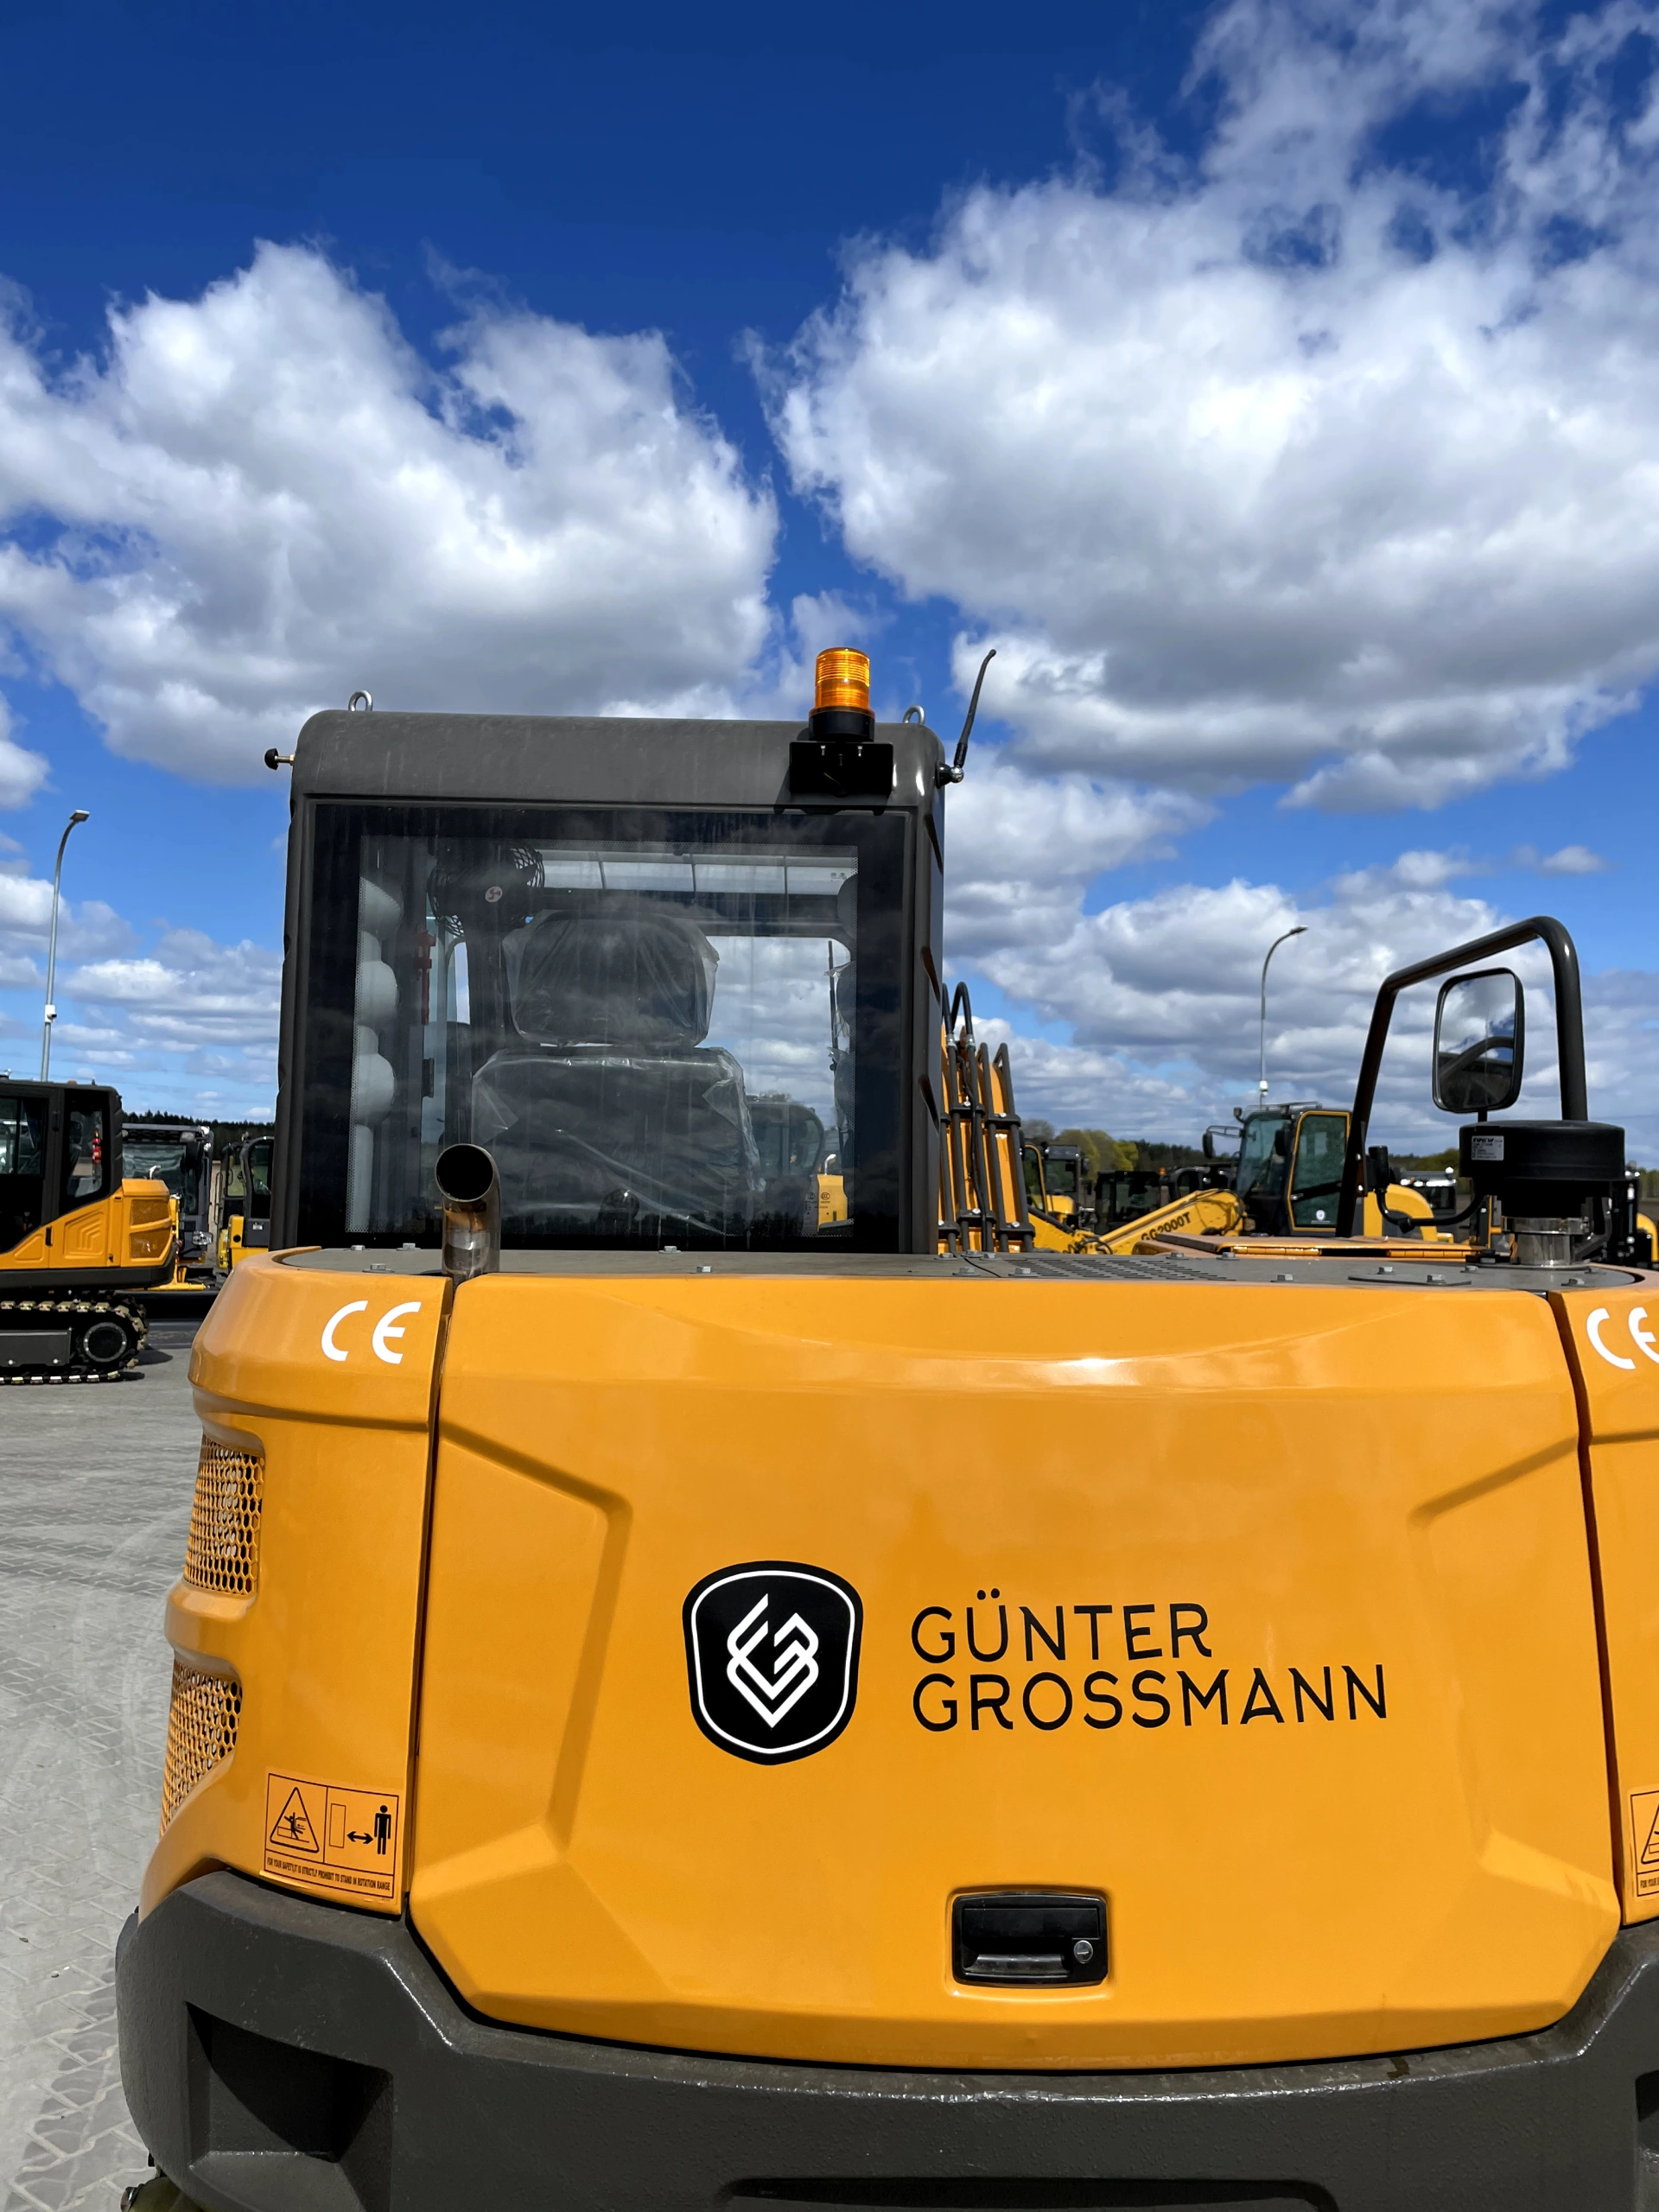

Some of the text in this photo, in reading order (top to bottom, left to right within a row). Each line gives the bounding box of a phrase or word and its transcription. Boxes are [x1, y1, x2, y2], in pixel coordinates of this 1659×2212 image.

[321, 1300, 422, 1364] CE
[911, 1587, 1212, 1664] GÜNTER
[912, 1664, 1387, 1732] GROSSMANN
[302, 1866, 317, 1877] STRICTLY
[340, 1874, 352, 1885] STAND
[377, 1880, 391, 1891] RANGE
